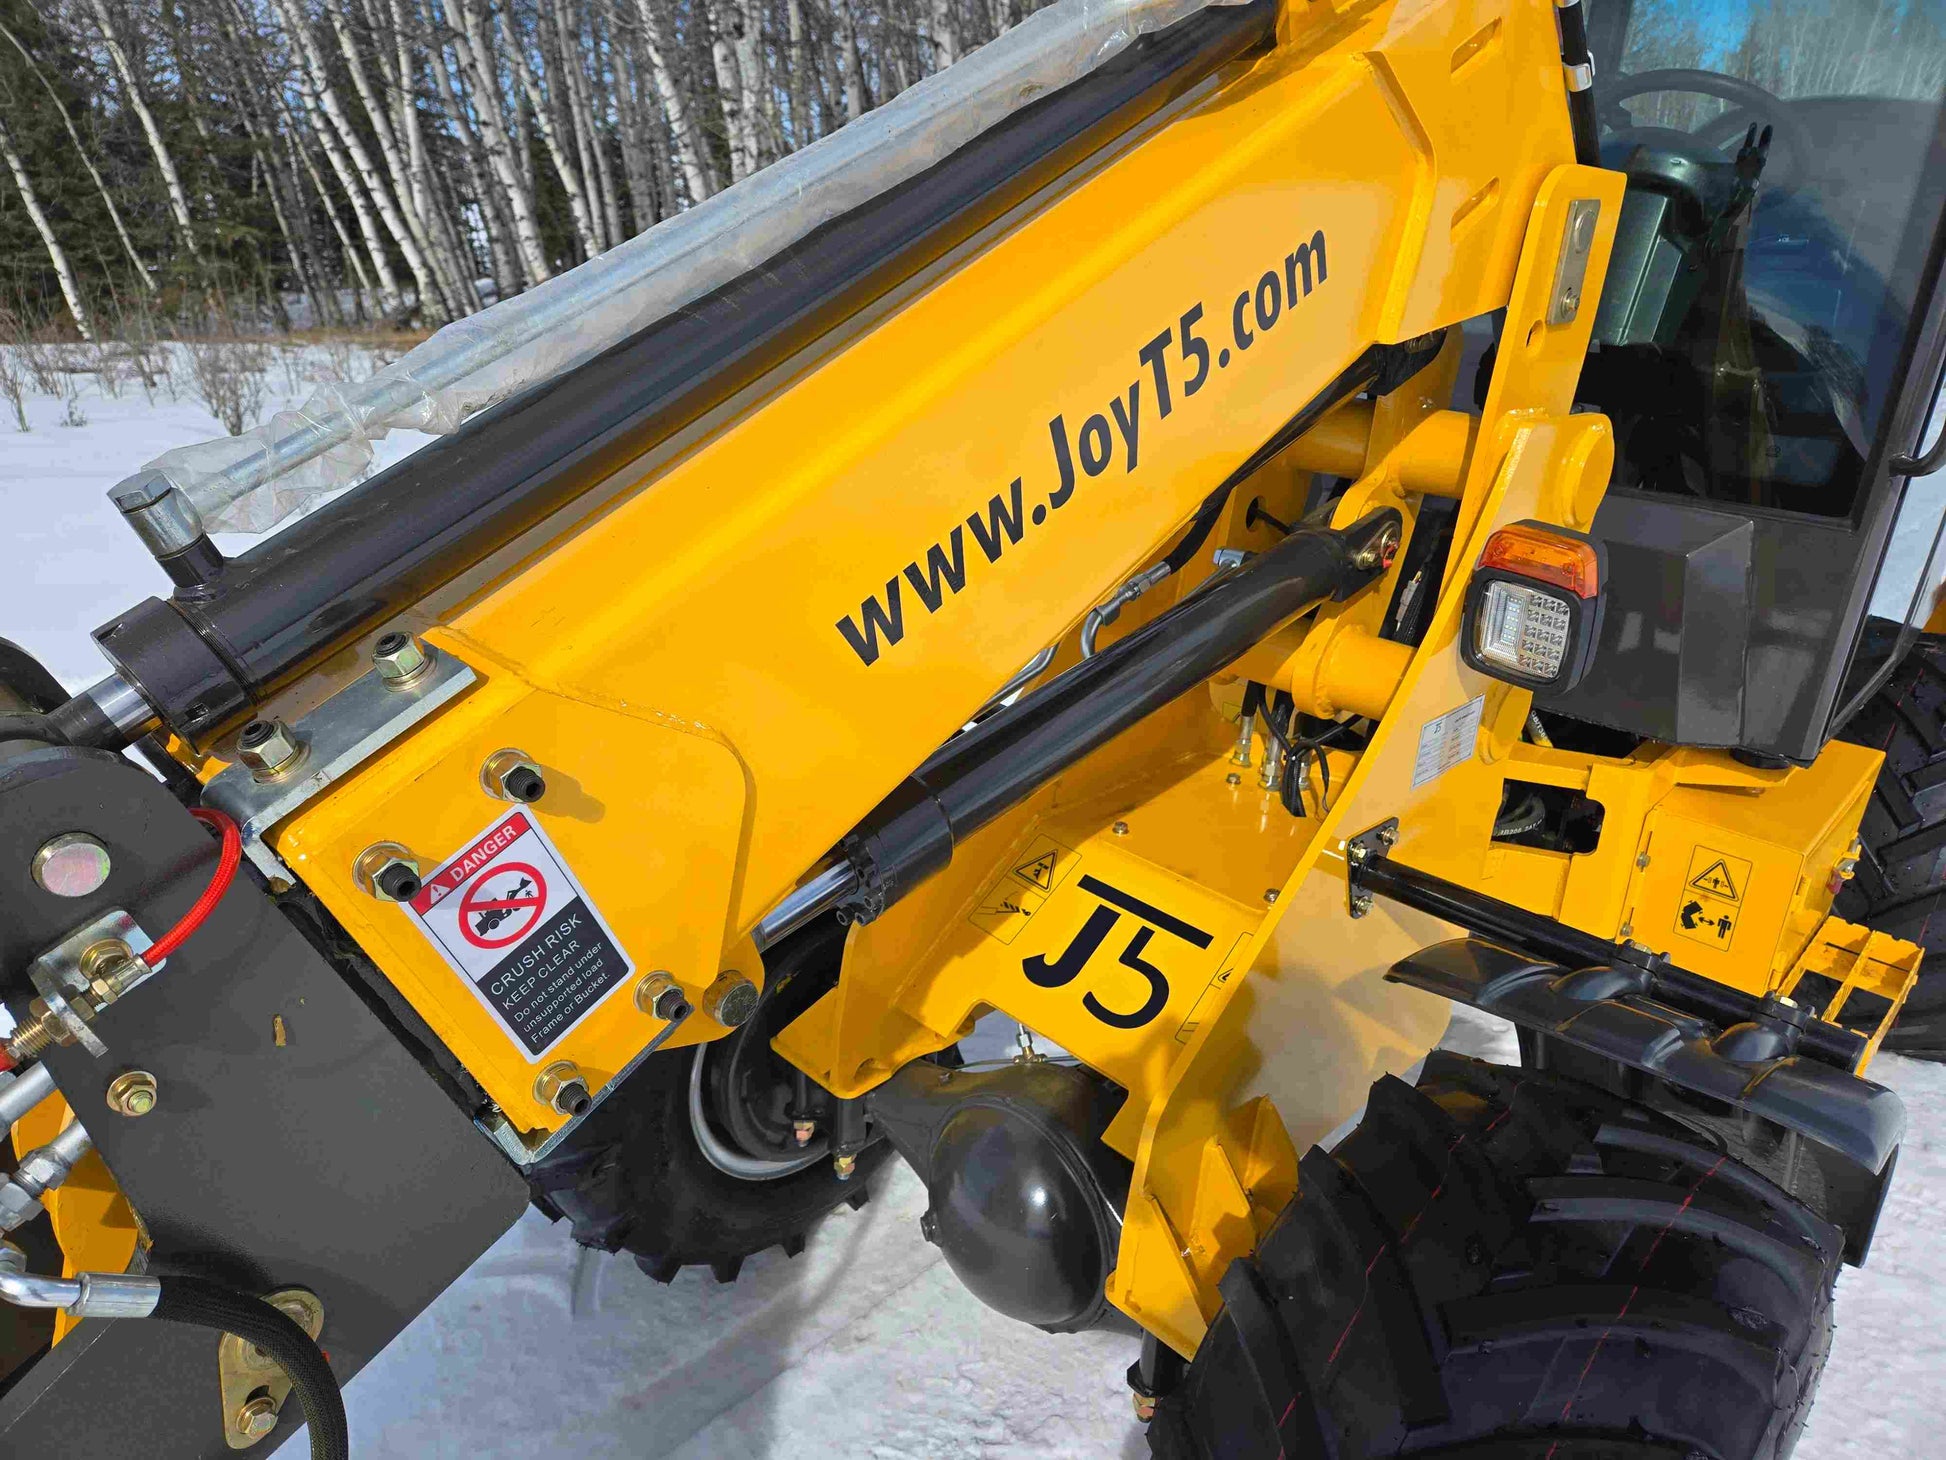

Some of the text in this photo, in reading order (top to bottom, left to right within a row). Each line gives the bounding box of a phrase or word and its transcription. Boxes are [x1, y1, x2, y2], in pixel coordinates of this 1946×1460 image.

[835, 229, 1328, 667] www.JoyT5.com
[450, 825, 517, 882] DANGER
[491, 913, 582, 995] CRUSH RISK
[502, 940, 580, 1010] KEEP CLEAR
[514, 942, 601, 1022] Do not stand under
[1022, 874, 1214, 1029] J5
[523, 959, 604, 1033] unsupported load
[531, 973, 611, 1043] Frame or Bucket.
